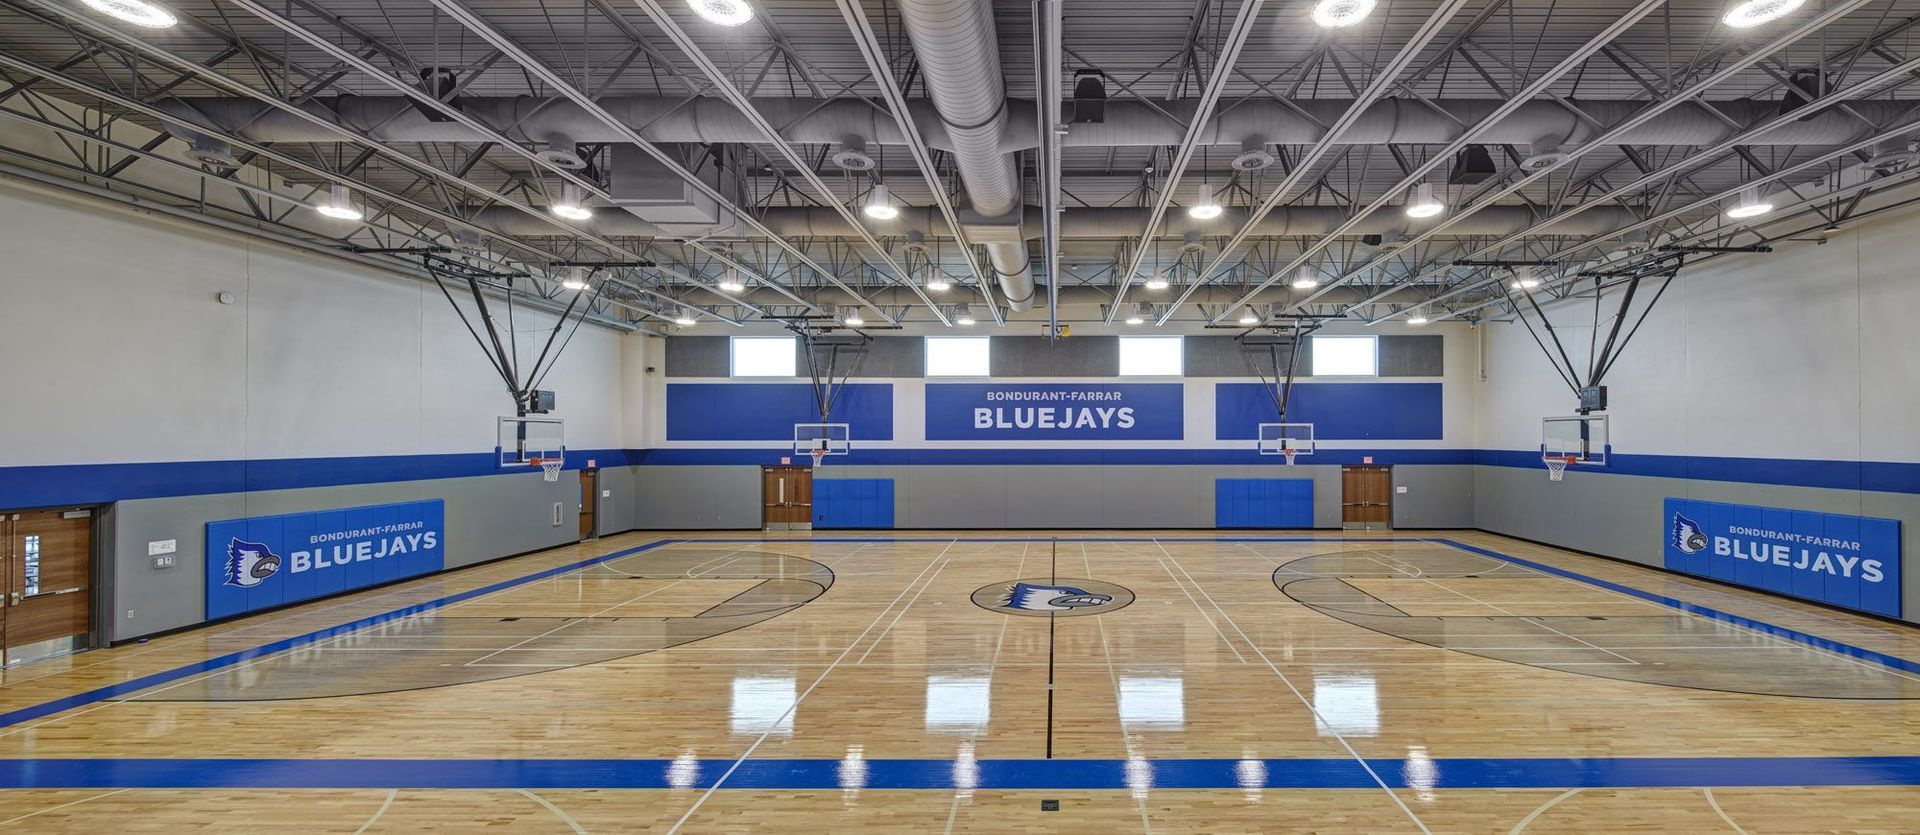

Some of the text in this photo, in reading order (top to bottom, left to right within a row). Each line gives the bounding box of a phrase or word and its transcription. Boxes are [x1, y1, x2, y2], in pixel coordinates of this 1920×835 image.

[987, 391, 1122, 401] BONDURANT-FARRAR
[974, 407, 1135, 429] BLUEJAYS
[310, 521, 424, 544] BONDURANT-FARRAR
[1729, 525, 1861, 551] BONDURANT-FARRAR
[290, 531, 437, 574] BLUEJAYS
[1714, 536, 1884, 583] BLUEJAYS
